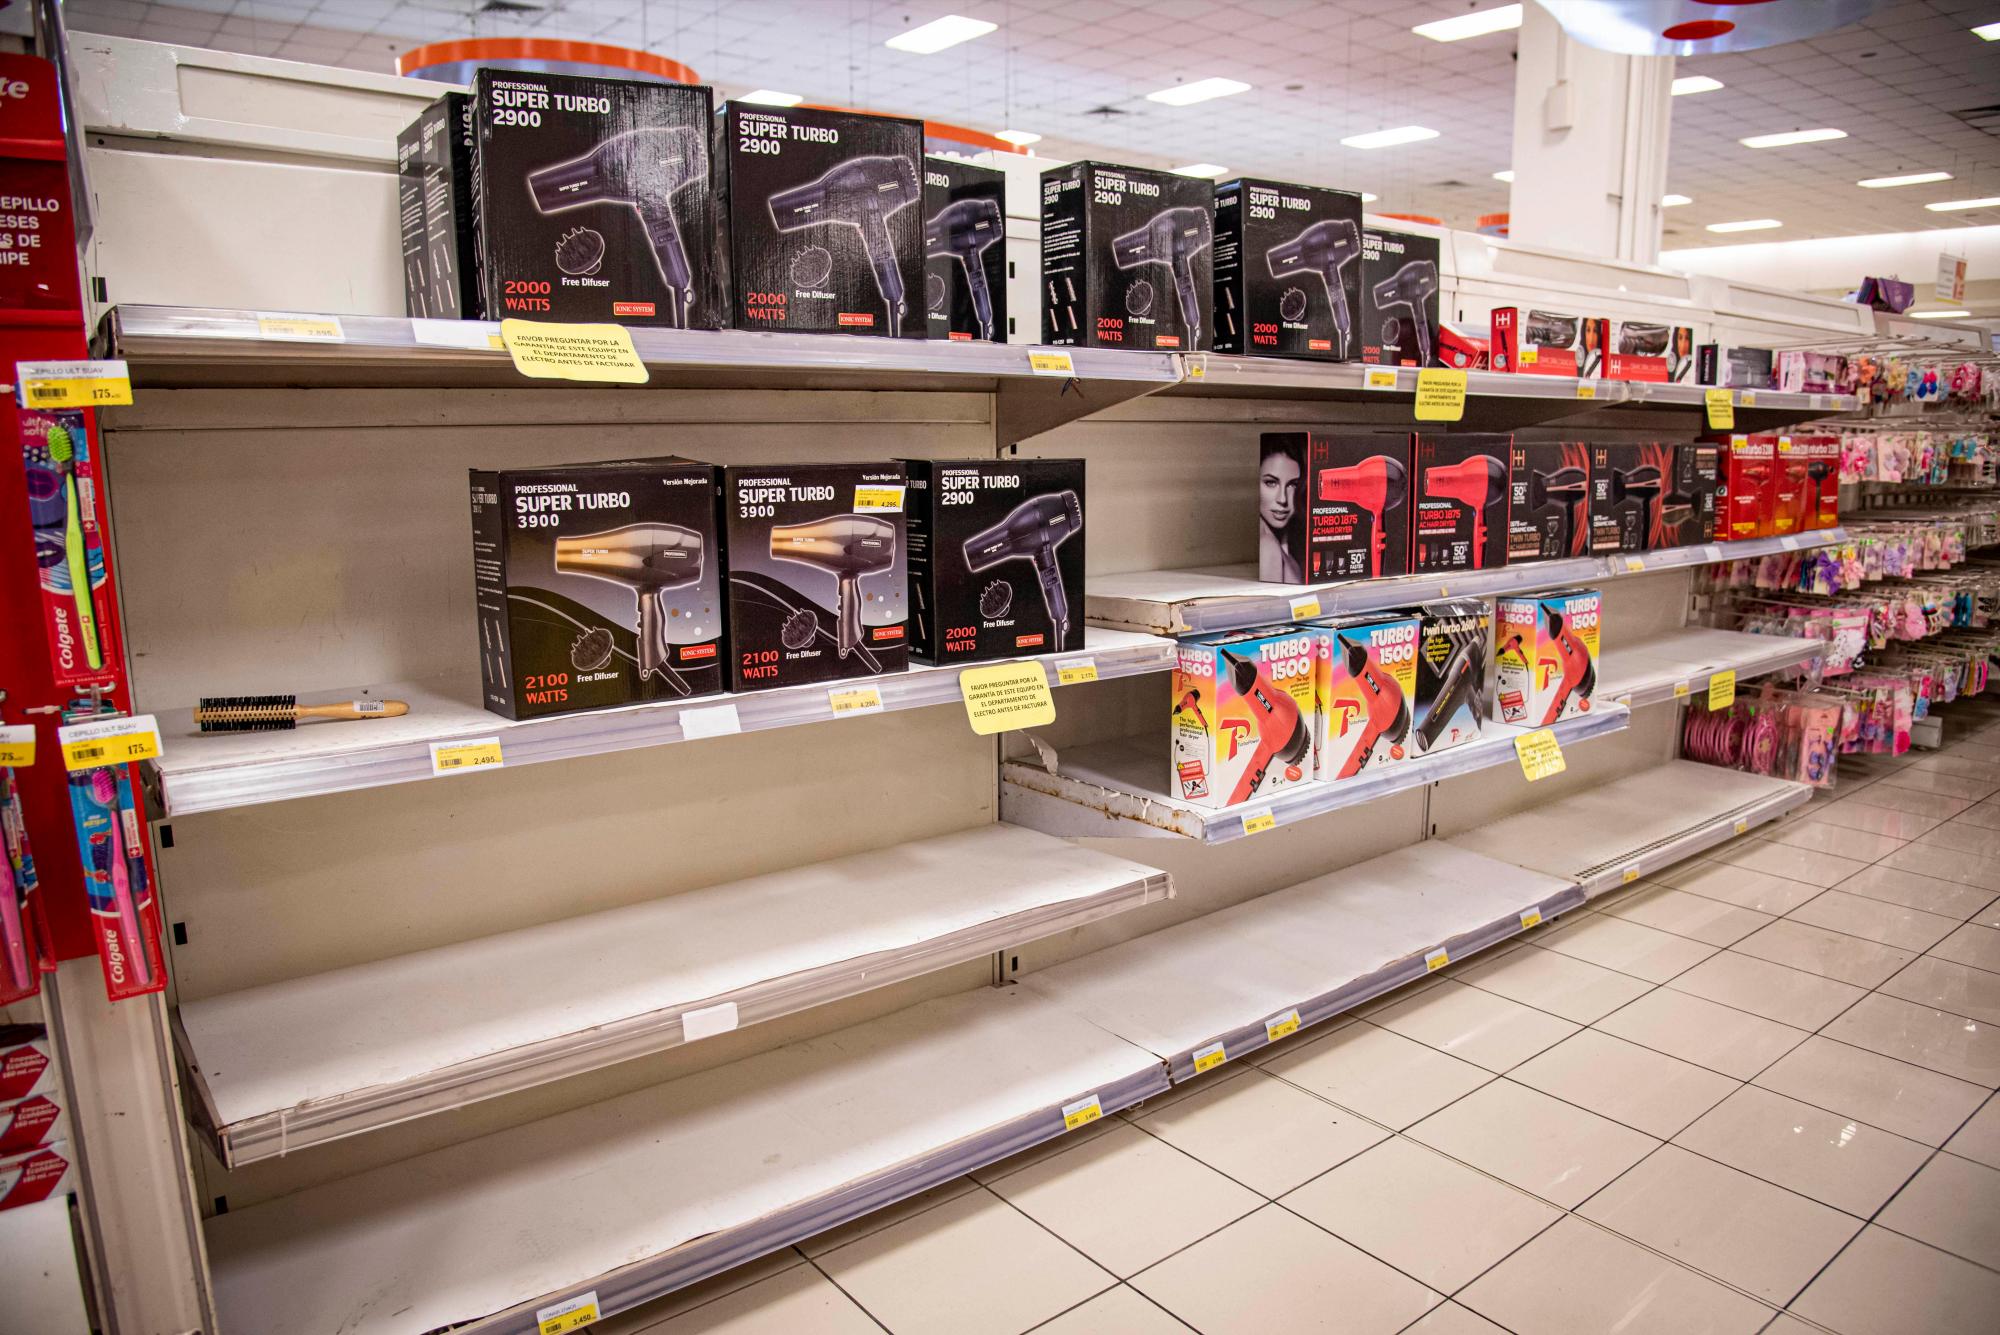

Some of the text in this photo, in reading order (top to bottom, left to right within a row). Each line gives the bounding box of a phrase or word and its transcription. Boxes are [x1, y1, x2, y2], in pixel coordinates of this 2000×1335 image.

[493, 81, 548, 92] PROFESSIONAL
[493, 90, 610, 114] SUPER TURBO
[493, 109, 541, 127] 2900
[740, 113, 787, 124] PROFESSIONAL
[740, 121, 838, 143] SUPER TURBO
[740, 138, 781, 155] 2900
[1095, 170, 1126, 179] PROFESSIONAL
[1044, 179, 1081, 196] SUPER TURBO
[1095, 177, 1159, 197] SUPER TURBO
[1, 196, 59, 212] EPILLO
[1044, 194, 1059, 205] 2900
[1095, 191, 1122, 205] 2900
[1220, 196, 1237, 208] TURBO
[1250, 193, 1311, 211] SUPER TURBO
[1250, 207, 1275, 219] 2900
[18, 234, 41, 247] DE
[1362, 239, 1404, 253] SUPER TURBO
[0, 252, 30, 265] IPE
[1362, 250, 1379, 260] 2900
[505, 281, 550, 294] 2000
[562, 277, 610, 287] Free Difuser
[747, 292, 786, 305] 2000
[796, 290, 835, 299] Free Difuser
[506, 298, 550, 311] WATTS
[616, 305, 653, 314] IONIC SYSTEM
[748, 308, 785, 320] WATTS
[1098, 318, 1123, 328] 2000
[1254, 324, 1278, 334] 2000
[545, 337, 590, 345] PREGUNTAR
[1098, 330, 1123, 341] WATTS
[1254, 335, 1277, 344] WATTS
[544, 351, 606, 359] DEPARTAMENTO
[1362, 346, 1380, 354] 2000
[663, 478, 707, 486] Versión Mejorada
[739, 478, 791, 487] PROFESSIONAL
[911, 480, 926, 489] TURBO
[942, 475, 1020, 490] SUPER TURBO
[515, 483, 578, 494] PROFESSIONAL
[484, 494, 497, 504] TURBO
[739, 486, 835, 504] SUPER TURBO
[942, 491, 973, 505] 2900
[516, 492, 630, 513] SUPER TURBO
[740, 506, 775, 518] 3900
[1419, 509, 1460, 520] TURBO 1875
[518, 513, 560, 529] 3900
[1313, 514, 1357, 526] TURBO 1875
[1498, 603, 1534, 613] TURBO
[1565, 597, 1598, 614] TURBO
[984, 619, 1015, 628] Free Difuser
[1505, 614, 1534, 624] 1500
[1572, 612, 1597, 629] 1500
[946, 626, 977, 639] 2000
[1423, 625, 1440, 636] twin
[1441, 623, 1460, 635] turbo
[56, 608, 74, 669] Colgate
[1371, 625, 1415, 647] TURBO
[682, 647, 715, 657] IONIC SYSTEM
[946, 640, 976, 652] WATTS
[1259, 636, 1311, 662] TURBO
[743, 651, 779, 665] 2100
[800, 650, 821, 658] Difuser
[1380, 644, 1414, 664] 1500
[743, 665, 778, 679] WATTS
[1181, 661, 1212, 677] 1500
[1271, 657, 1311, 681] 1500
[525, 673, 568, 689] 2100
[577, 671, 619, 683] Free Difuser
[989, 679, 1019, 689] PREGUNTAR
[1017, 686, 1035, 694] EQUIPO
[526, 689, 568, 704] WATTS
[989, 695, 1028, 706] DEPARTAMENTO
[974, 709, 996, 717] ELECTRO
[997, 706, 1013, 714] ANTES
[1022, 701, 1048, 710] FACTURAR
[1180, 728, 1202, 736] professional
[474, 756, 495, 765] 2,495
[106, 929, 125, 984] Colgate
